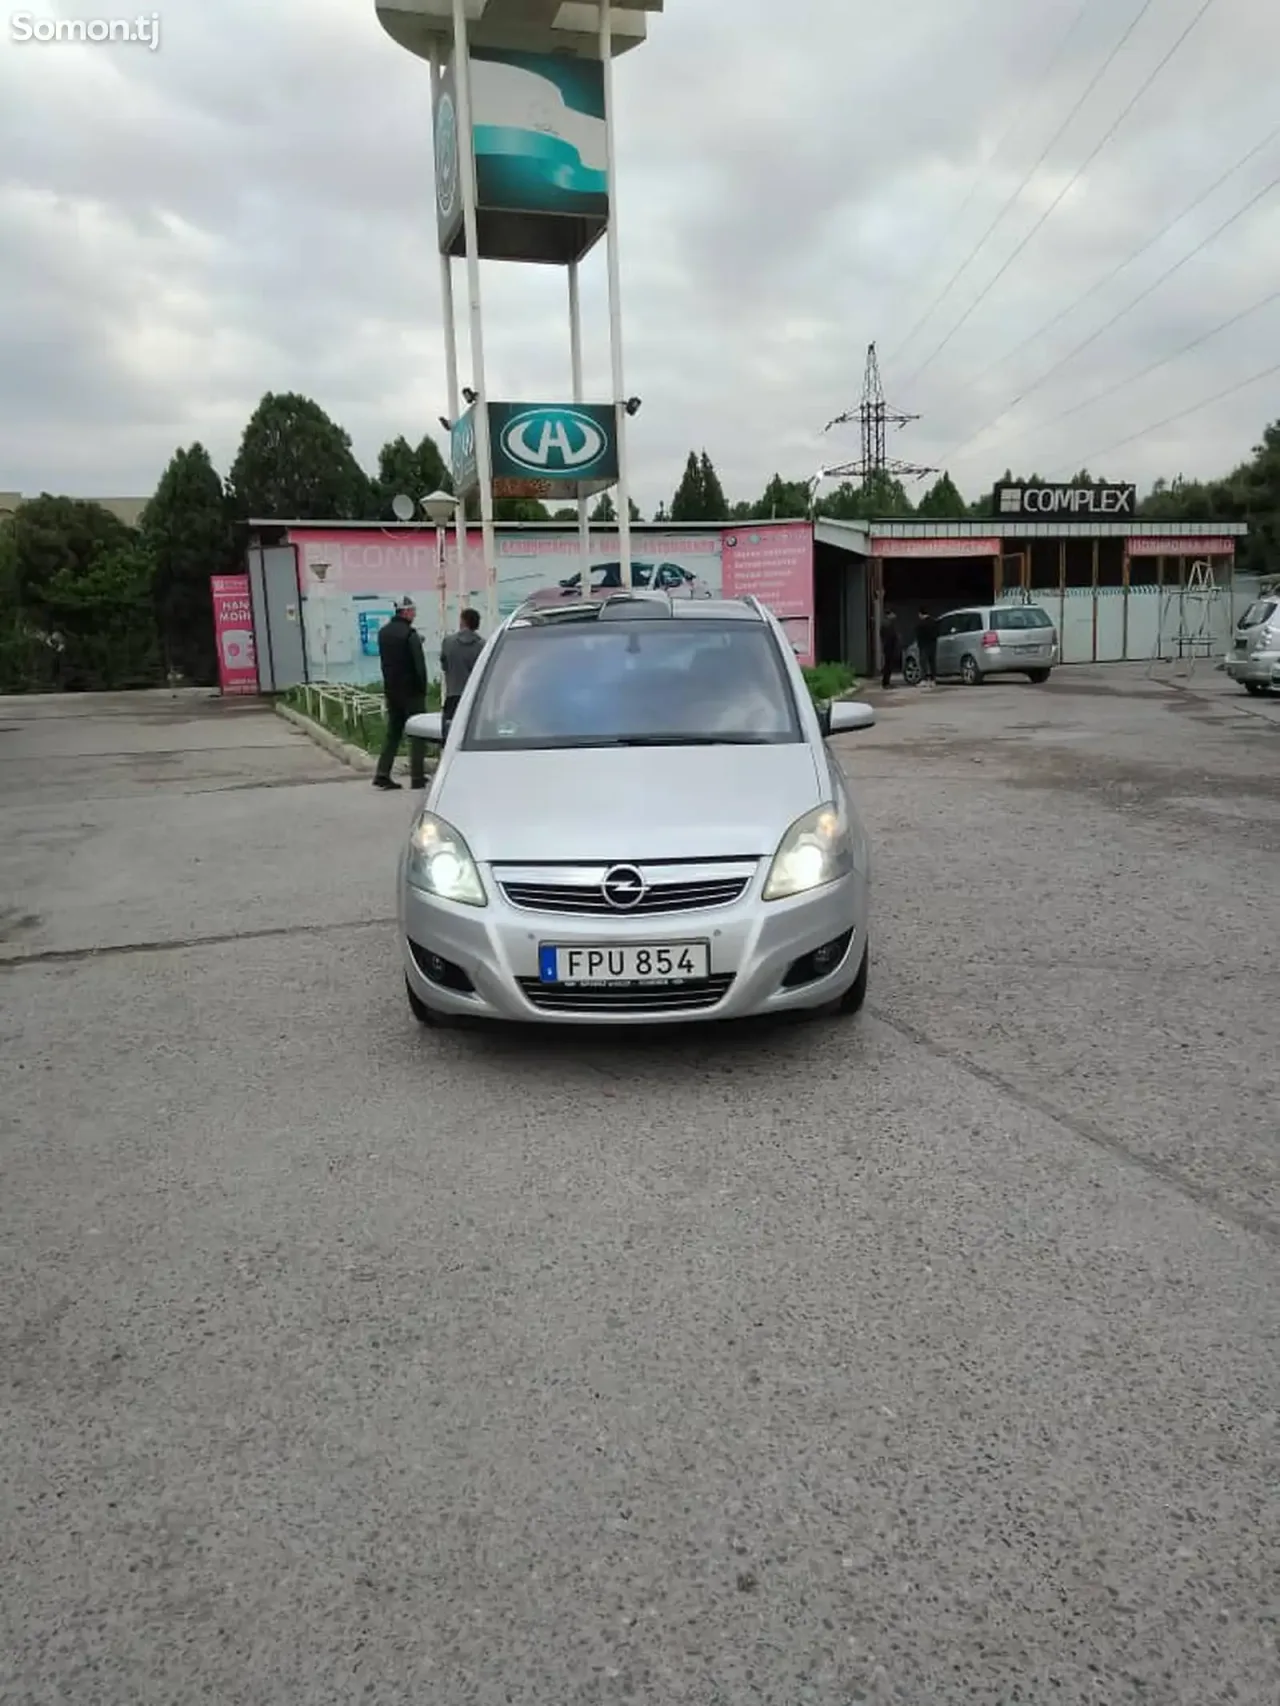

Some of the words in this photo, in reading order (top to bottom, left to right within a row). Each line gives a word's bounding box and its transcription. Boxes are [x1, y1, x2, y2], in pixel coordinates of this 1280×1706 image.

[1024, 488, 1131, 512] COMPLEX
[568, 950, 623, 976] FPU
[634, 948, 693, 974] 854
